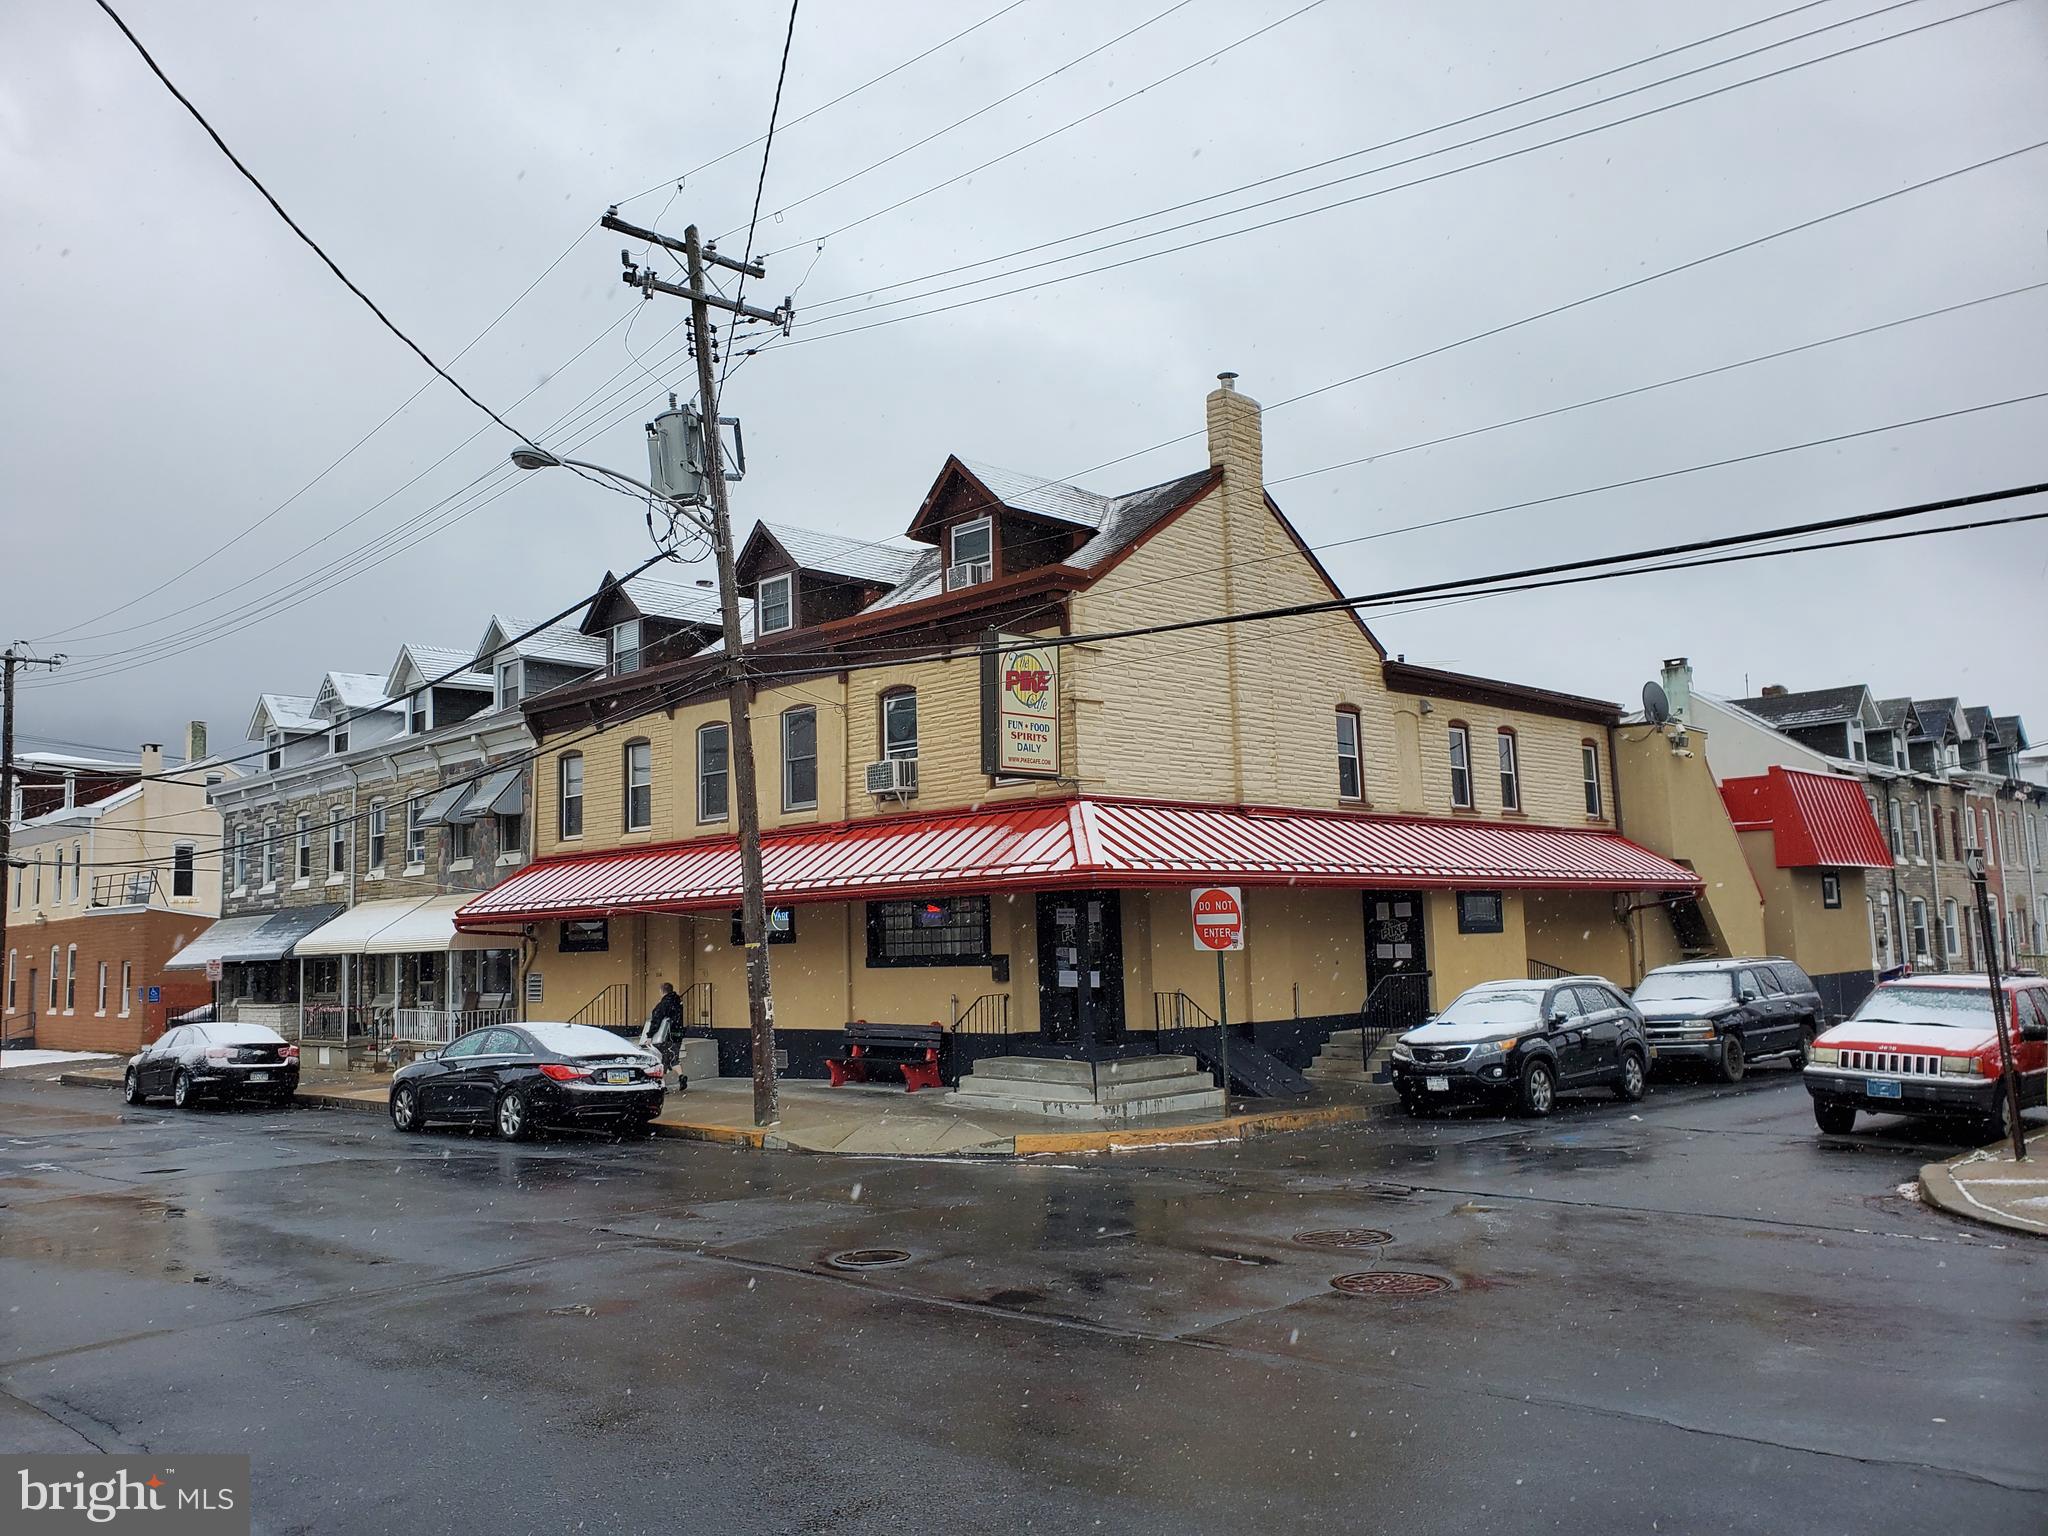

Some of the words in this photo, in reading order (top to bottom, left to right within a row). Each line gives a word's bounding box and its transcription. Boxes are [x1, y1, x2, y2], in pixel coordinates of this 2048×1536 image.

[1006, 671, 1051, 693] PIKE
[1008, 720, 1024, 730] FUN
[1030, 722, 1050, 732] FOOD
[1010, 731, 1048, 742] SPIRITS
[1017, 743, 1042, 753] DAILY
[1199, 901, 1211, 911] DO
[1215, 900, 1233, 911] NOT
[1203, 928, 1231, 938] ENTER
